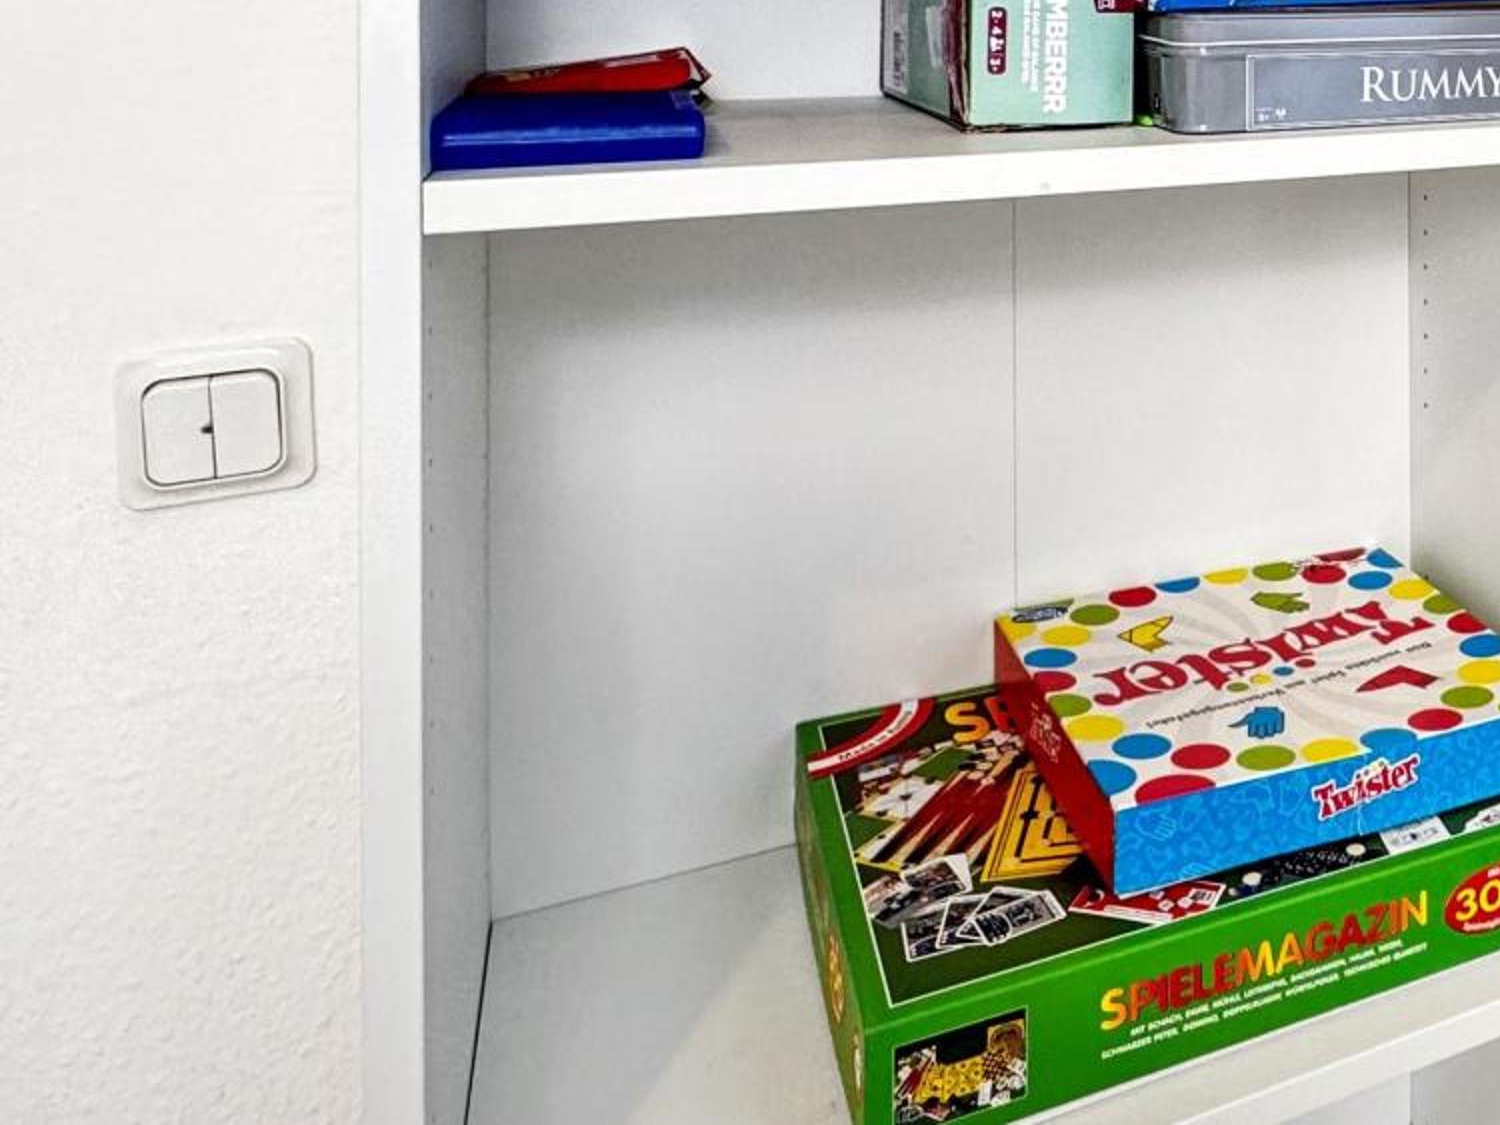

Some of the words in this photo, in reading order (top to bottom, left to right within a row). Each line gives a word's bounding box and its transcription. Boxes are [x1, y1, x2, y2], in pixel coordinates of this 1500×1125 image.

[1093, 601, 1434, 706] Twister
[1312, 754, 1420, 820] Twister
[1100, 890, 1428, 1031] SPIELEMAGAZIN
